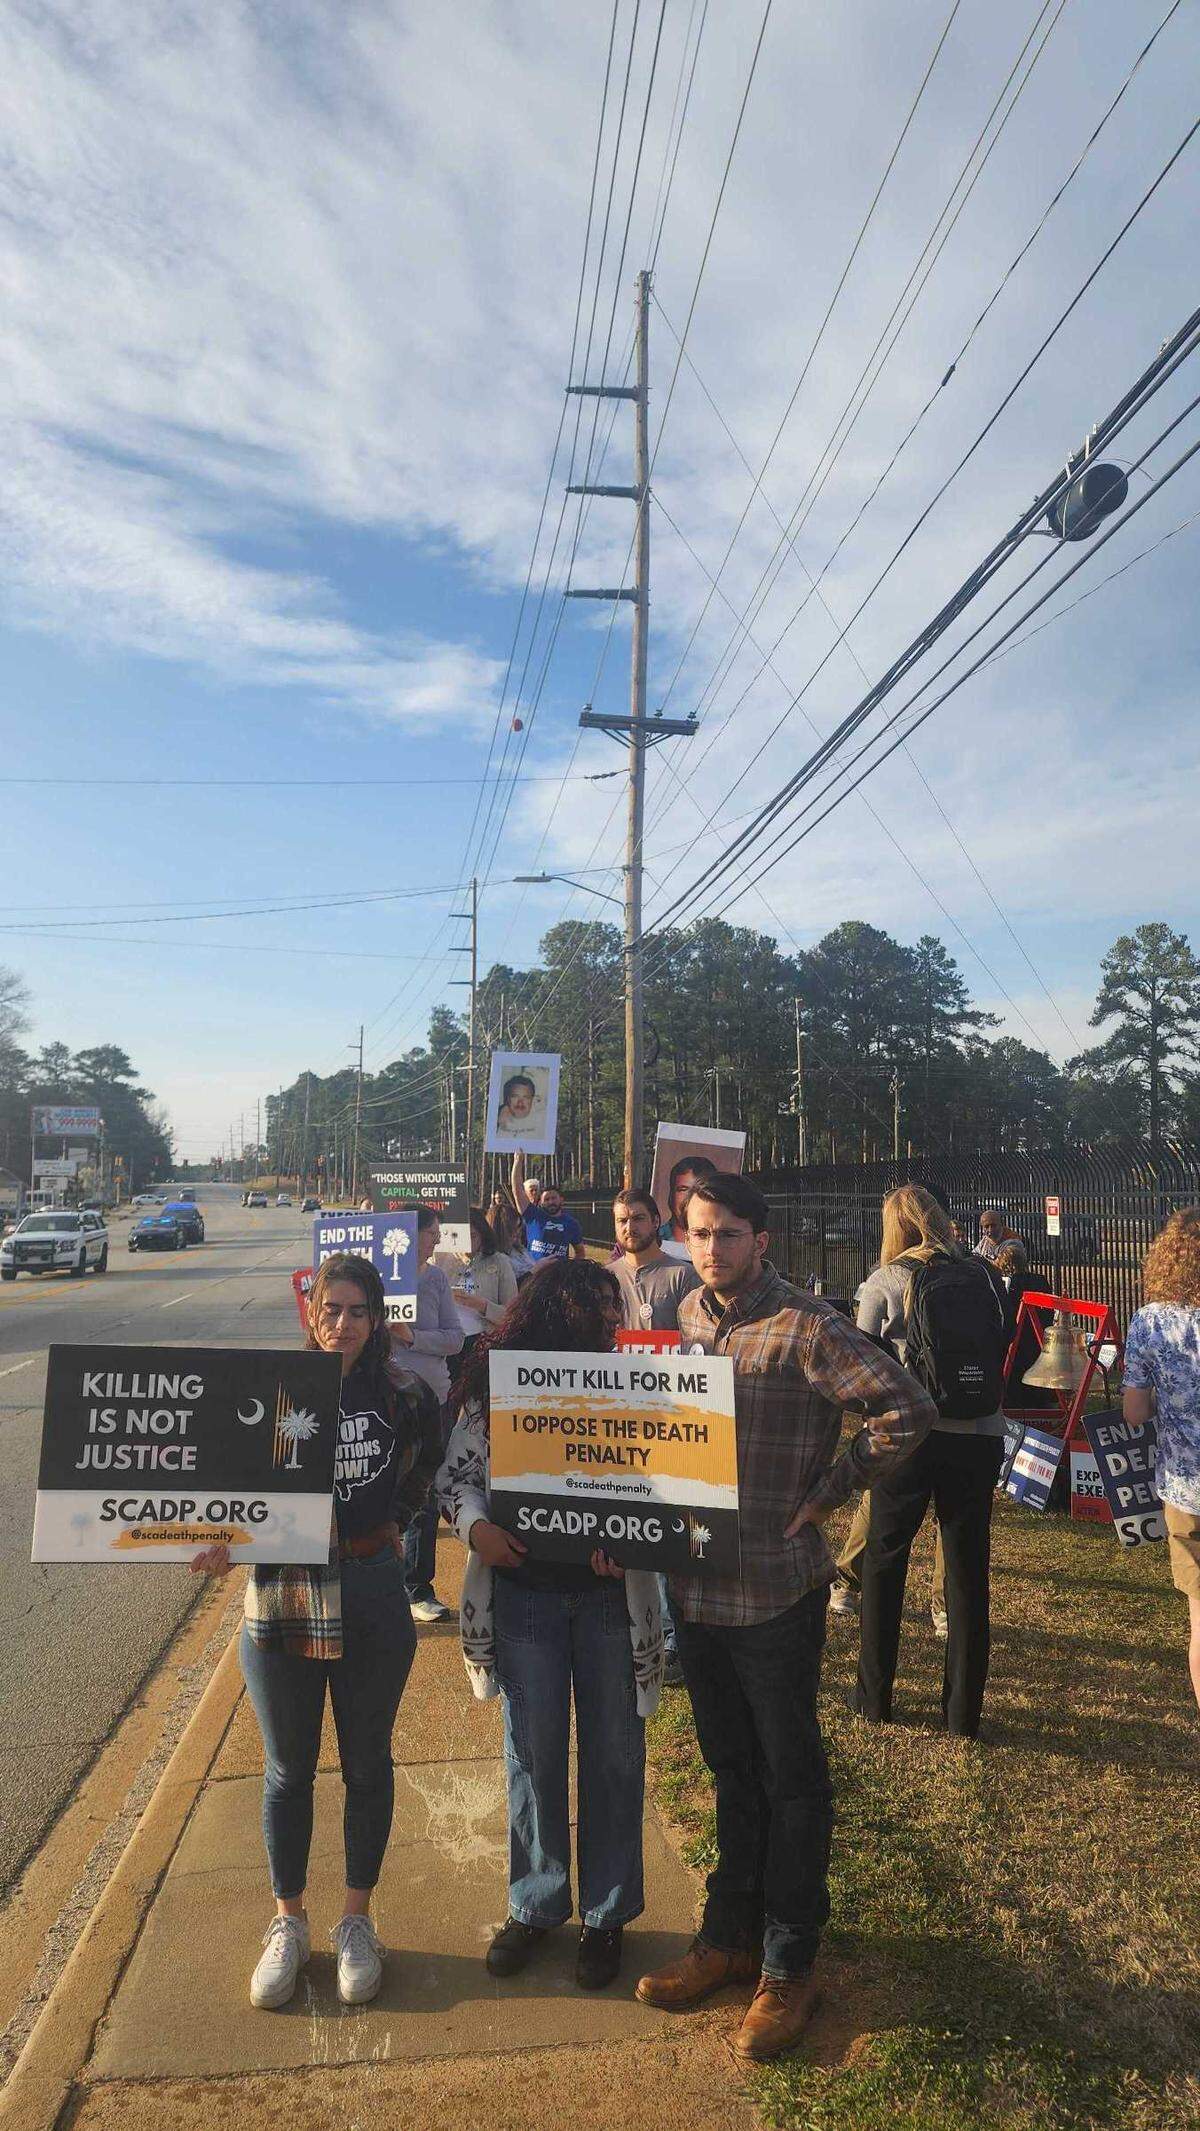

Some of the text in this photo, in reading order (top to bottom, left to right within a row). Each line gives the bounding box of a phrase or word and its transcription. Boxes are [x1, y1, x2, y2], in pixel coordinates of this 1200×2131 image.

[405, 1173, 446, 1183] WITHOUT
[447, 1173, 465, 1183] THE
[381, 1187, 457, 1198] CAPITAL, GET THE
[320, 1225, 374, 1244] END THE
[82, 1372, 204, 1399] KILLING
[517, 1367, 708, 1394] DON'T KILL FOR ME
[89, 1408, 193, 1435] IS NOT
[340, 1417, 369, 1442] OP
[512, 1414, 708, 1443] I OPPOSE THE DEATH
[75, 1444, 197, 1471] JUSTICE
[335, 1439, 380, 1460] UTIONS
[565, 1443, 651, 1466] PENALTY
[335, 1459, 369, 1480] OW!
[565, 1477, 652, 1496] @scadeathpenalty
[1076, 1483, 1106, 1498] EXE
[100, 1499, 269, 1523] SCADP.ORG
[131, 1529, 234, 1543] @scadeathpenalty
[517, 1506, 663, 1543] SCADP.ORG
